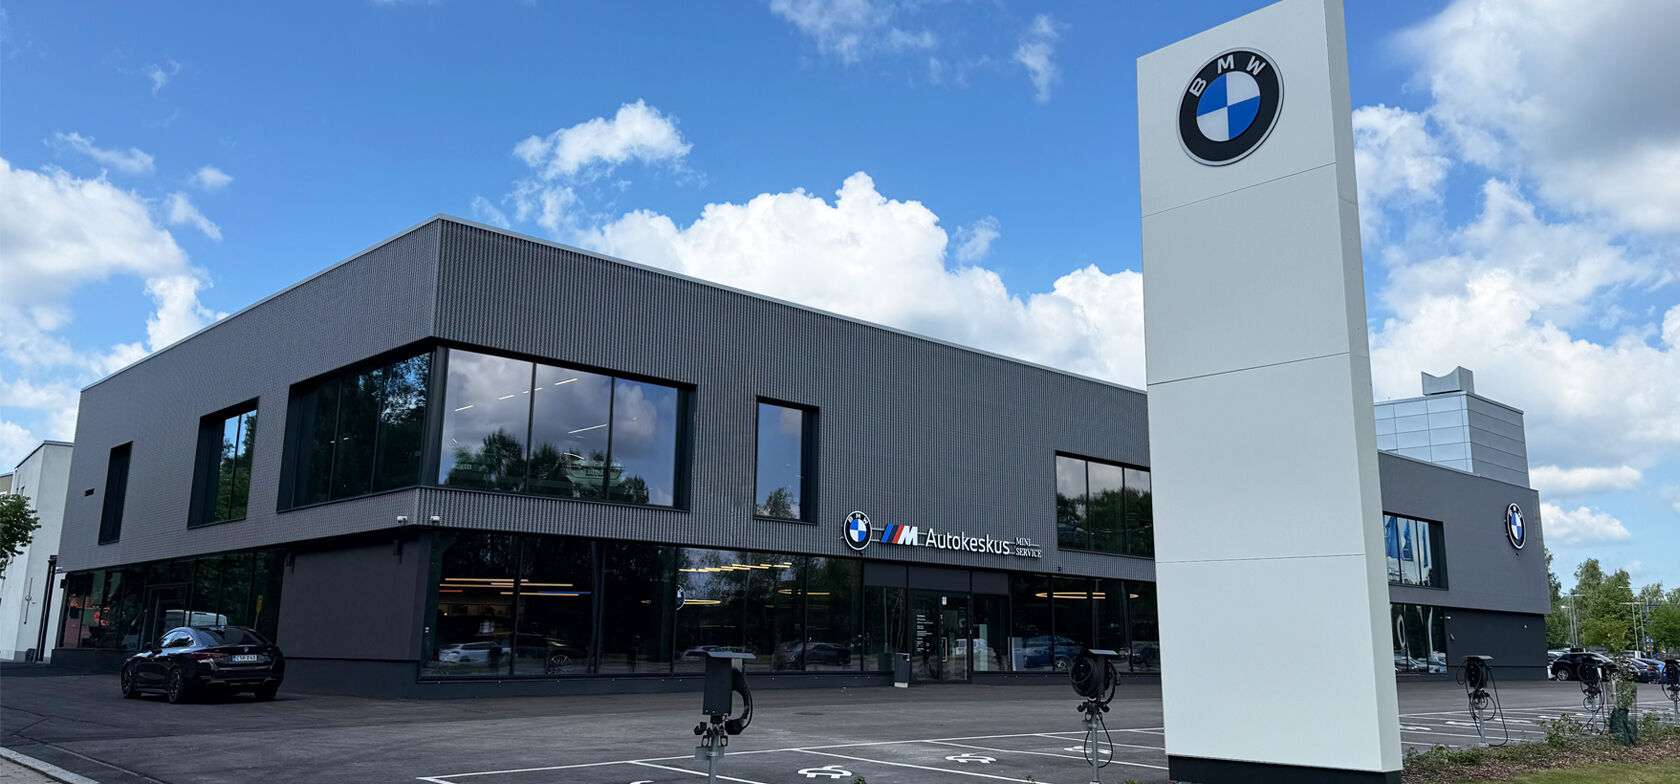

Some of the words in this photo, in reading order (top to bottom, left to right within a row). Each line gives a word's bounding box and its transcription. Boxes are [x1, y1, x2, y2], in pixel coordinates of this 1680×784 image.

[1189, 54, 1267, 97] BMW
[847, 513, 869, 524] BMW
[897, 525, 919, 546] M
[925, 528, 1010, 555] Autokeskus
[1015, 537, 1031, 547] MINI
[1015, 548, 1042, 558] SERVICE
